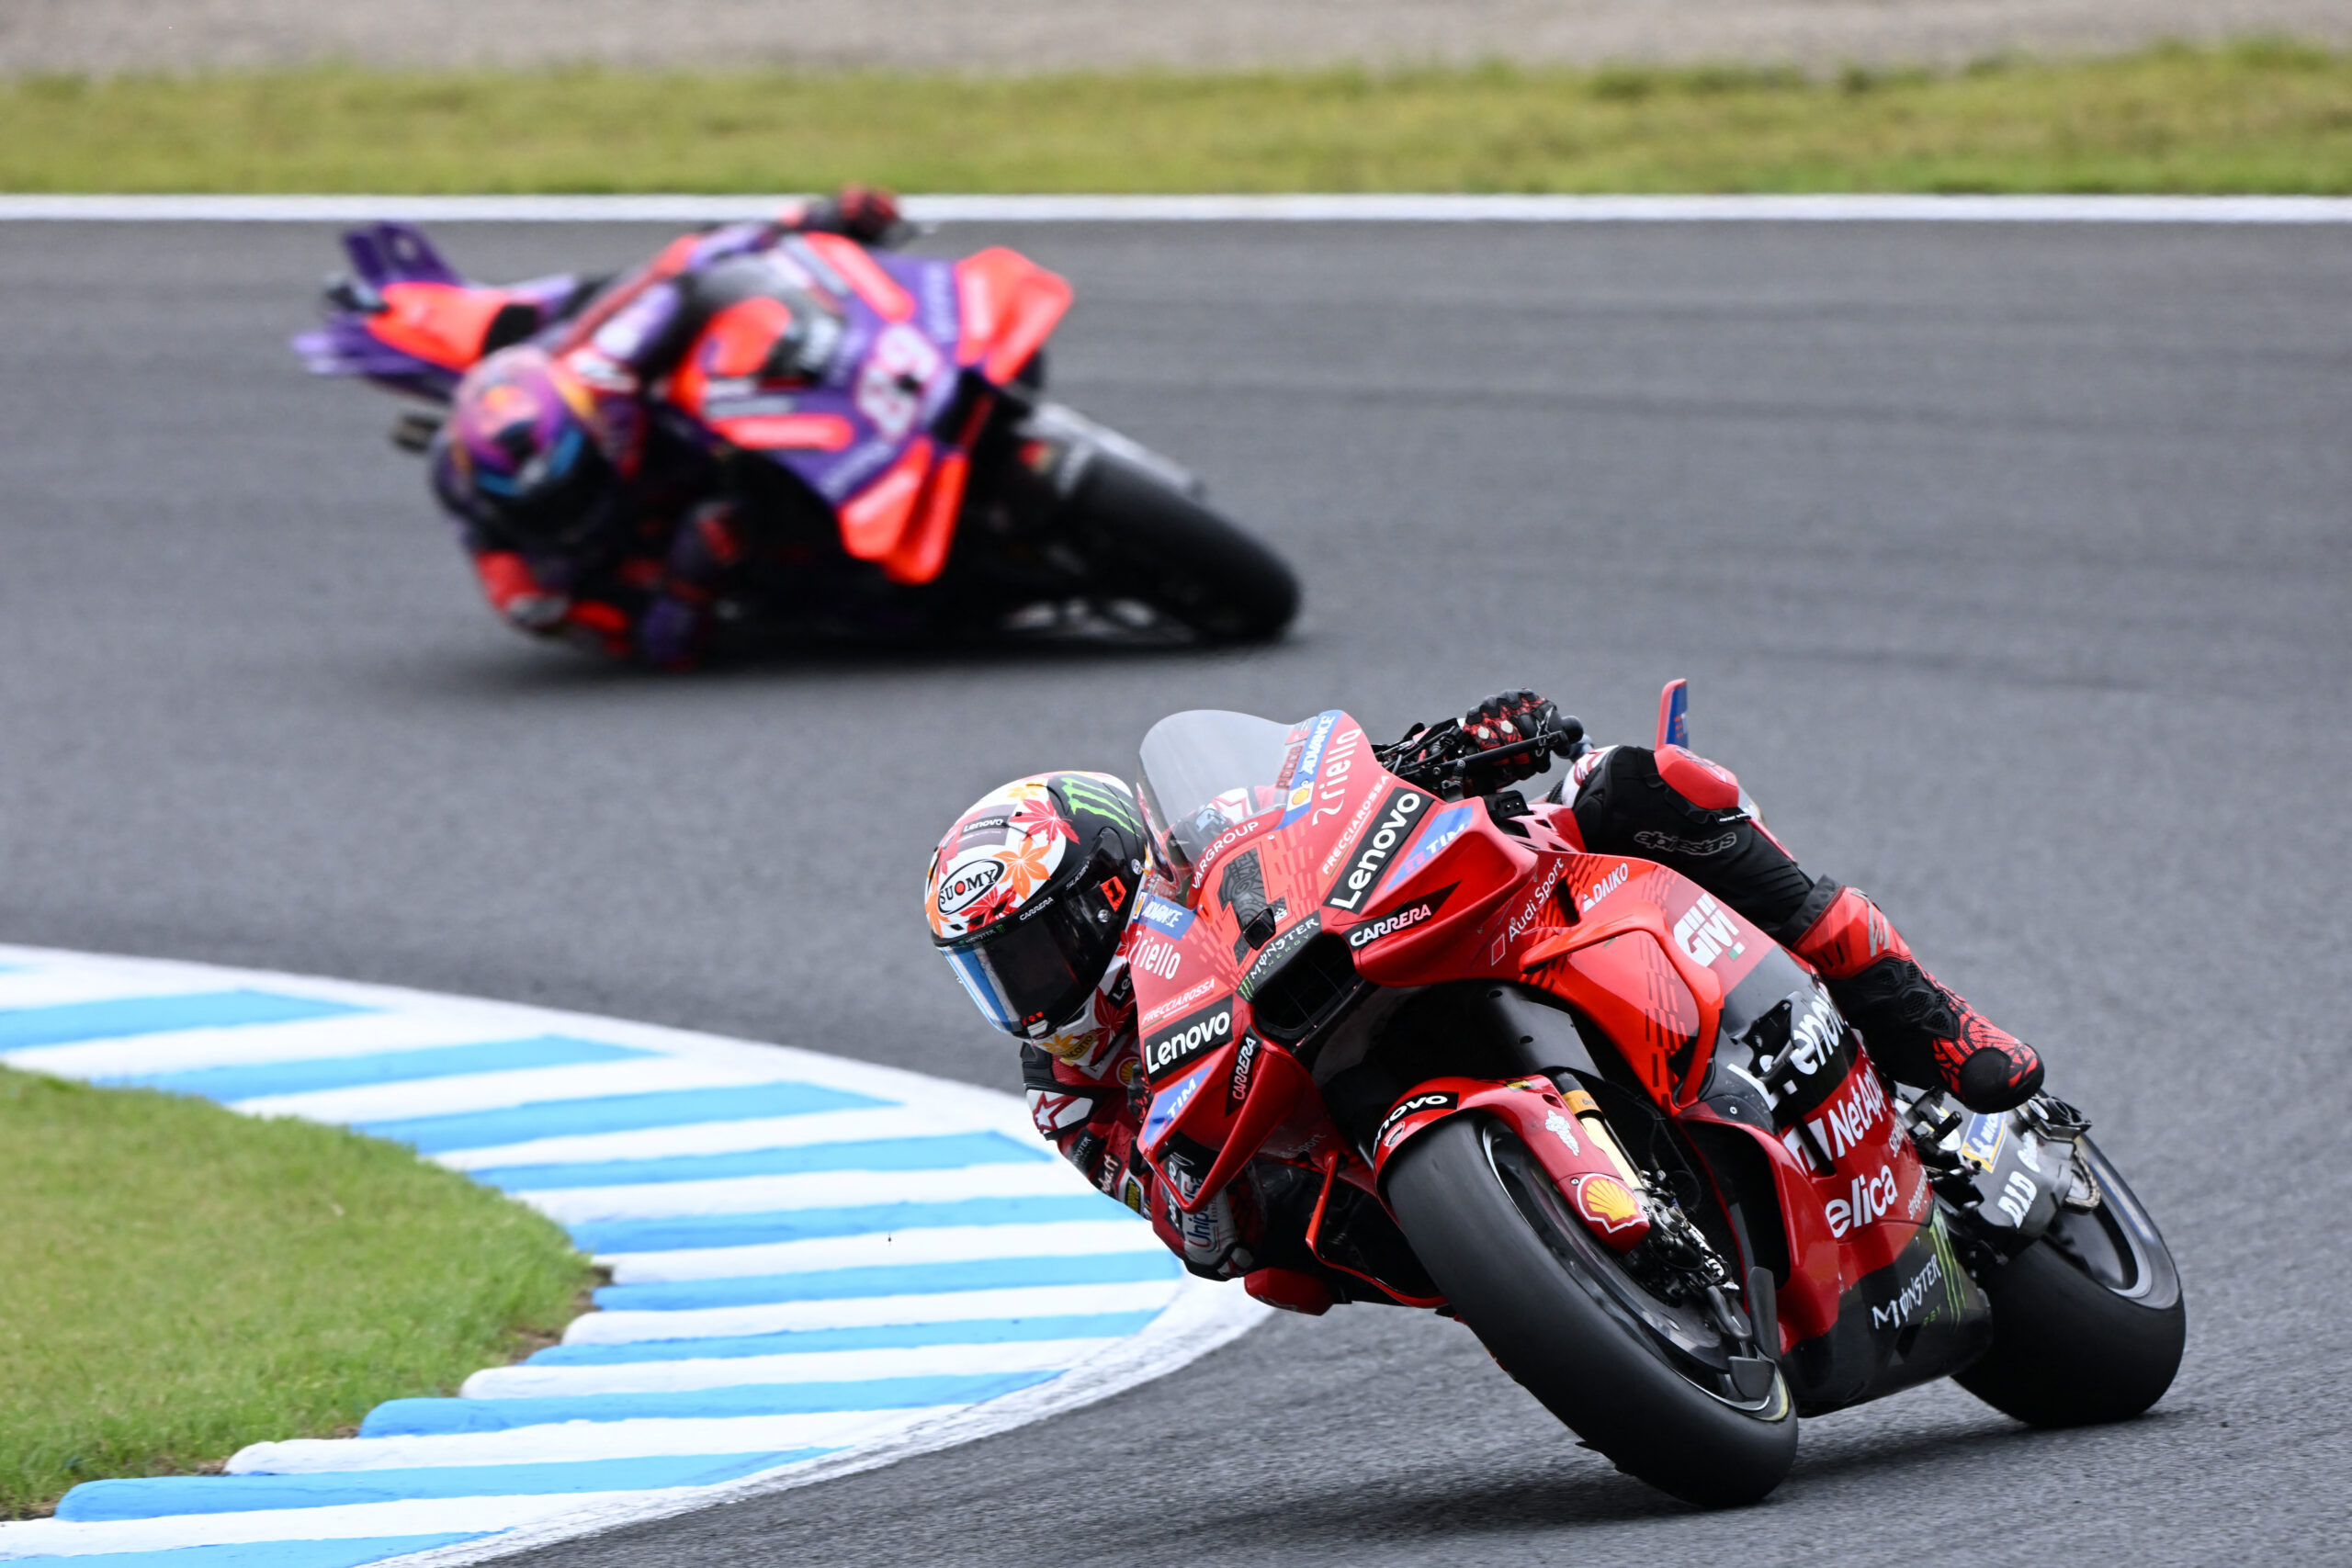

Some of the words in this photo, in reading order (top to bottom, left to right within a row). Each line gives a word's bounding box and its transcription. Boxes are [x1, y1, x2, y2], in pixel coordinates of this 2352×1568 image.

[1302, 715, 1336, 775] ADVANCE
[1319, 728, 1363, 802] riello
[963, 818, 1004, 833] Lenovo
[1322, 775, 1390, 875] FRECCIAROSSA
[1329, 792, 1421, 910] Lenovo
[1426, 822, 1467, 855] TIM
[939, 867, 998, 906] SUOMY
[1019, 896, 1055, 921] CARRERA
[1507, 899, 1537, 943] Audi
[1534, 857, 1565, 907] Sport
[1592, 862, 1630, 903] DAIKO
[1349, 904, 1432, 948] CARRERA
[1134, 936, 1182, 981] riello
[1261, 934, 1309, 976] ENERGY
[1141, 977, 1216, 1026] FRECCIAROSSA
[1145, 1010, 1231, 1075] Lenovo
[1232, 1035, 1257, 1101] CARRERA
[1167, 1077, 1197, 1119] TIM
[1827, 1063, 1887, 1158] NetApp
[1825, 1164, 1899, 1239] elica
[1871, 1253, 1942, 1330] MONSTER
